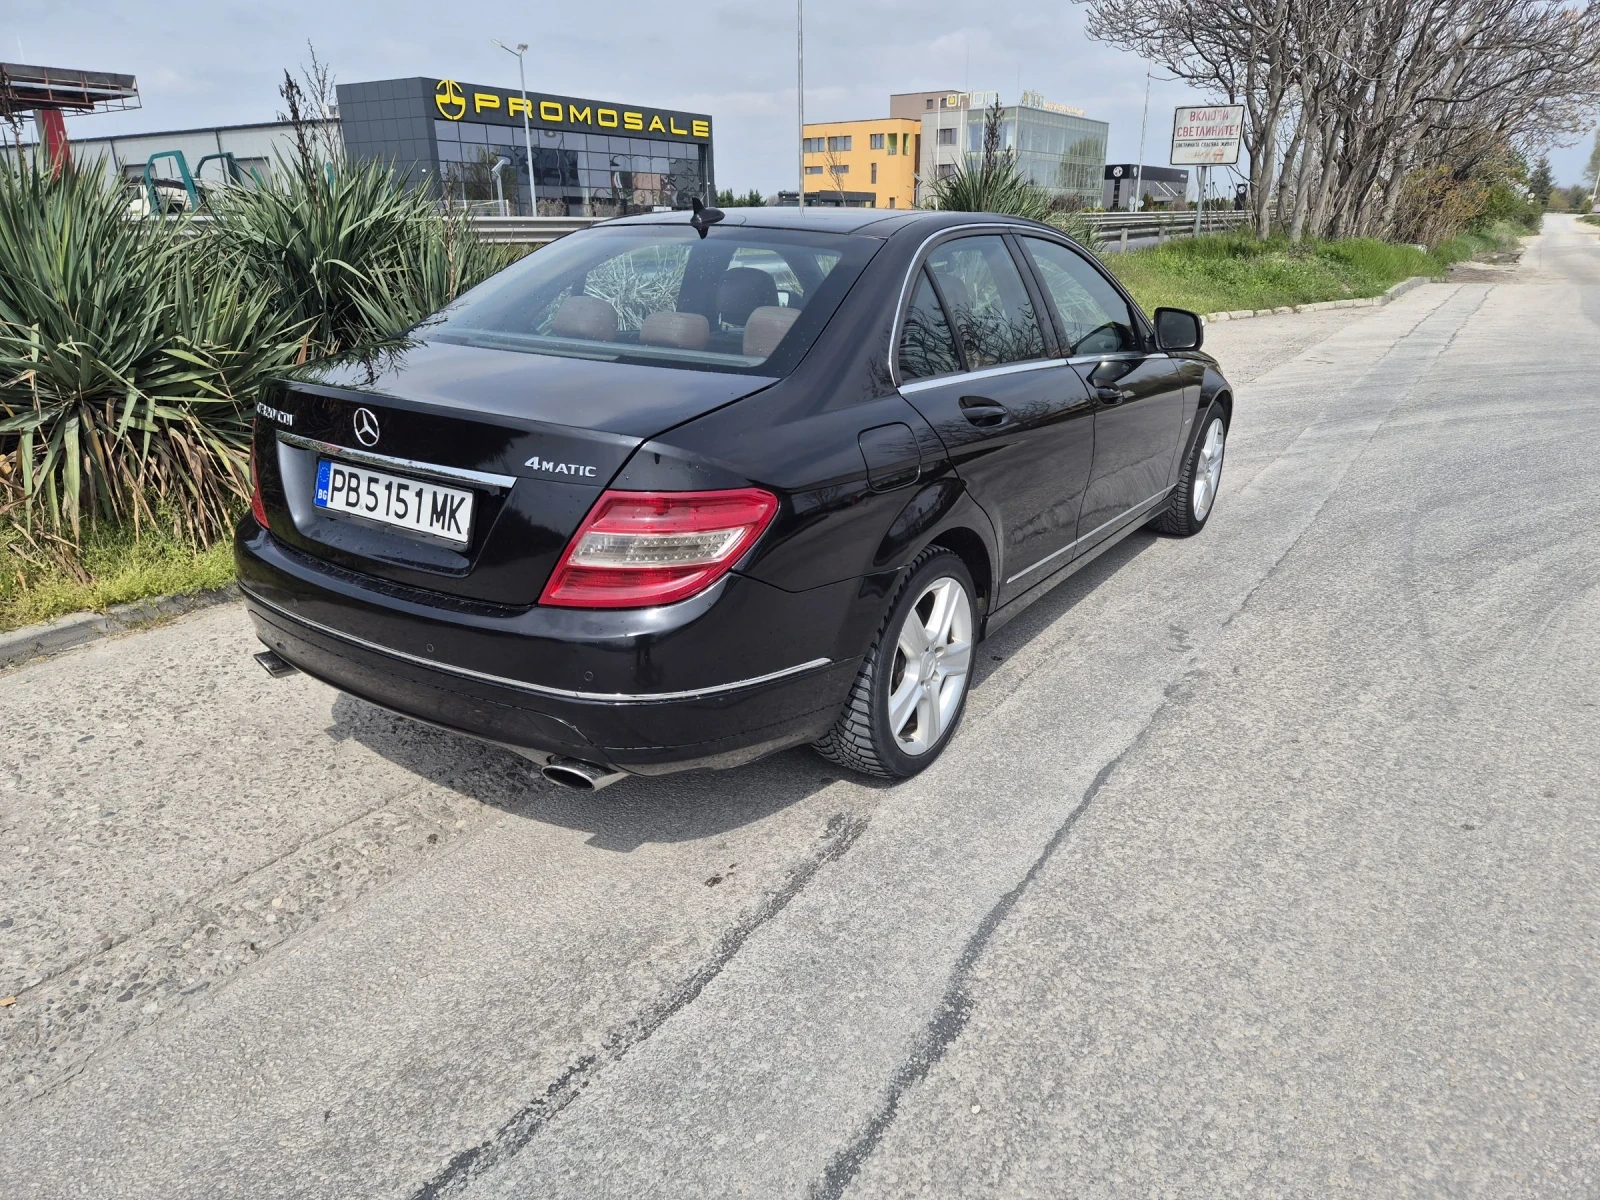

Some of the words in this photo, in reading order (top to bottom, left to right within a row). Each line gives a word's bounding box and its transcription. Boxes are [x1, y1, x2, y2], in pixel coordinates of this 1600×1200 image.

[474, 92, 709, 138] PROMOSALE
[524, 456, 597, 478] 4MATIC
[317, 488, 328, 500] BG
